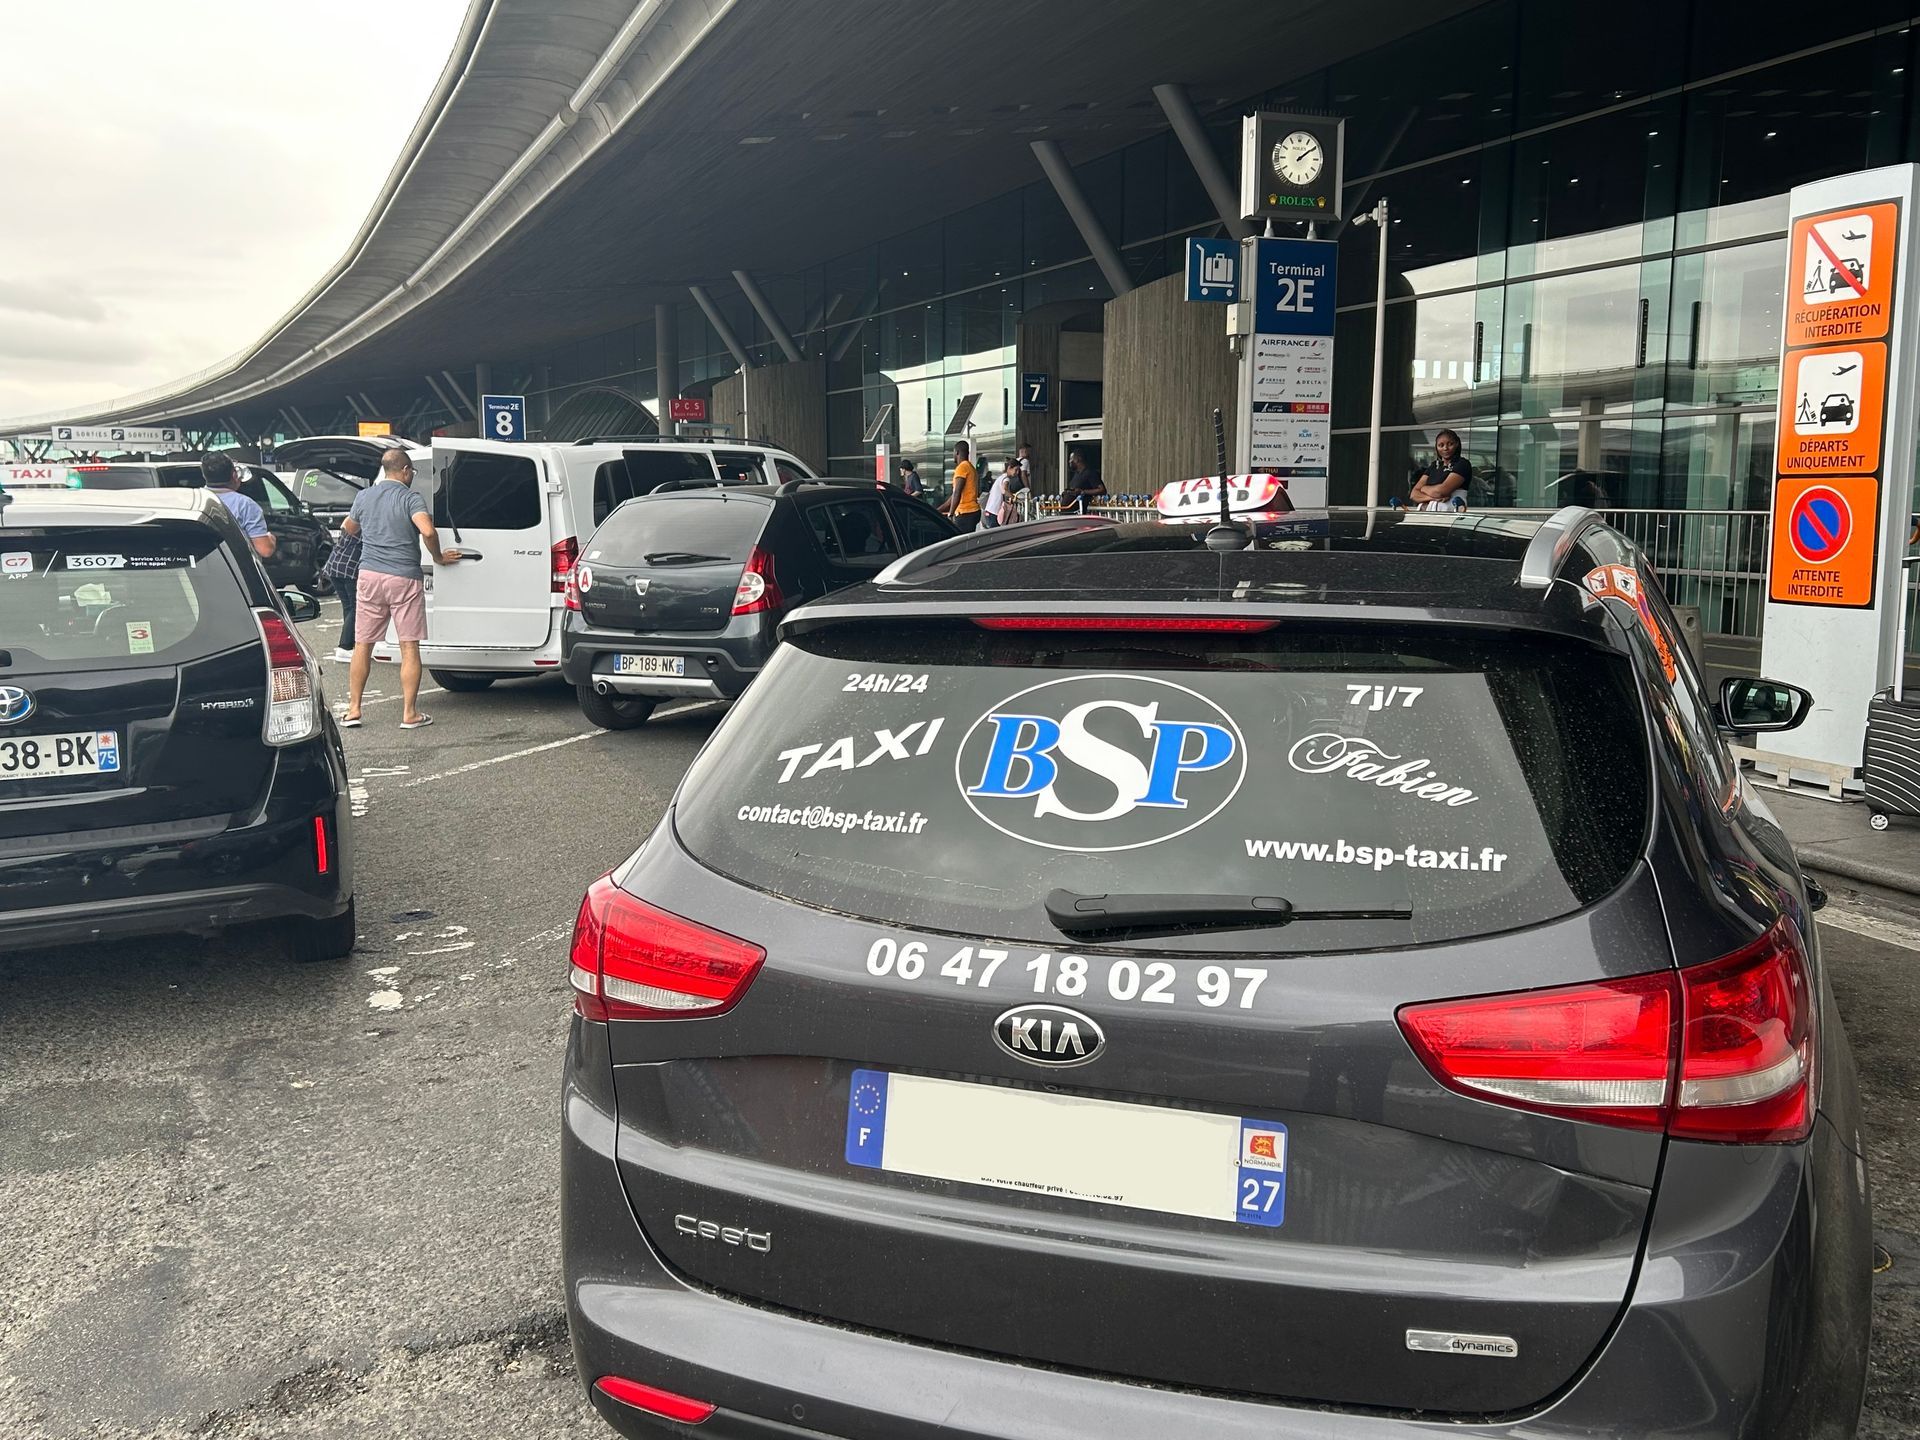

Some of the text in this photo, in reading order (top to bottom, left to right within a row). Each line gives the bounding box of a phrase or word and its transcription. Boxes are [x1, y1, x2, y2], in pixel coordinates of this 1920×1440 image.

[1280, 195, 1315, 207] ROLEX
[1269, 262, 1325, 277] Terminal
[1276, 278, 1315, 313] 2E
[1795, 303, 1881, 324] RÉCUPÉRATION
[1804, 321, 1862, 338] INTERDITE
[1030, 383, 1041, 402] 7
[510, 403, 519, 411] 2E
[496, 411, 513, 436] 8
[1799, 438, 1849, 453] DÉPARTS
[1787, 455, 1865, 470] UNIQUEMENT
[9, 469, 52, 478] TAXI
[5, 557, 28, 567] G7
[71, 556, 117, 567] 3607
[581, 571, 589, 588] A
[1792, 569, 1841, 582] ATTENTE
[1788, 583, 1844, 598] INTERDITE
[131, 629, 149, 639] 3
[842, 673, 930, 693] 24h/24
[1346, 684, 1424, 711] 7j/7
[100, 750, 117, 766] 75
[777, 717, 946, 784] TAXI
[966, 700, 1236, 821] BSP
[1288, 732, 1479, 807] Fabien
[737, 803, 929, 834] contact@bsp-taxi.fr
[1244, 838, 1508, 872] www.bsp-taxi.fr
[866, 938, 1269, 1010] 06 47 18 02 97
[1011, 1016, 1086, 1055] KIA
[859, 1127, 871, 1147] F
[1244, 1159, 1282, 1169] NORMANDIE
[1242, 1178, 1281, 1213] 27
[674, 1214, 771, 1253] cee'd
[1451, 1339, 1514, 1353] dynamics
